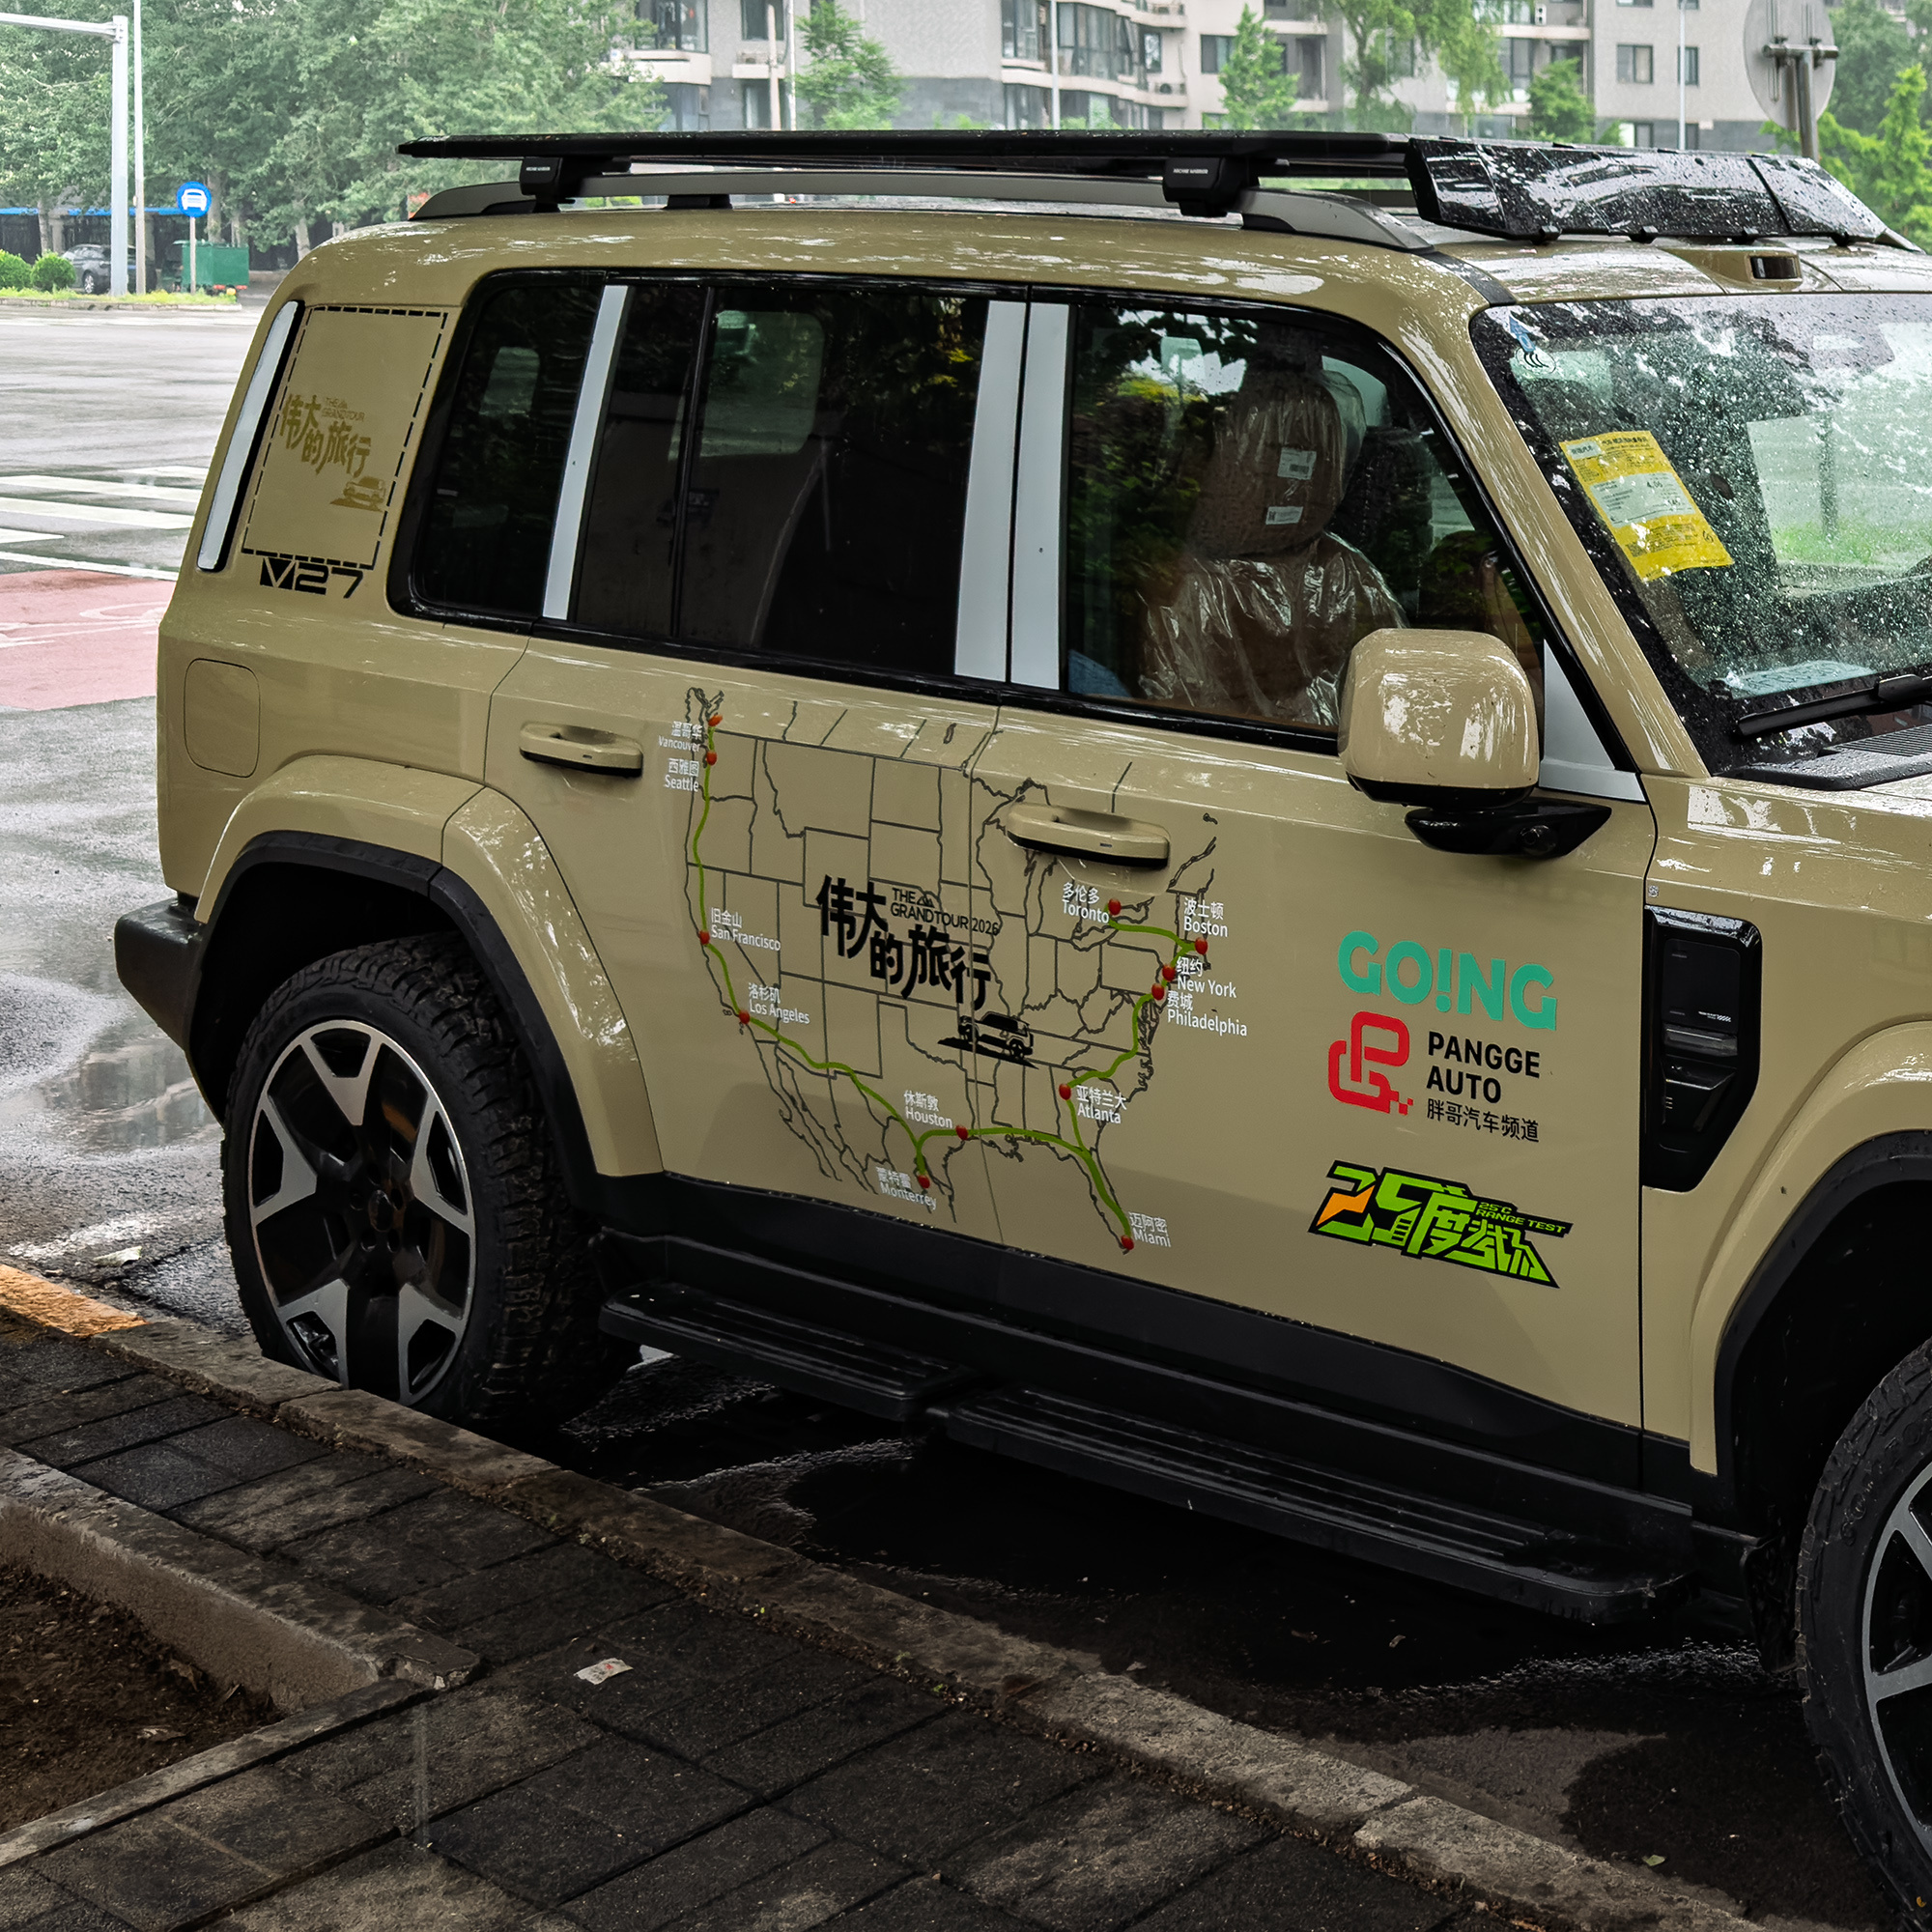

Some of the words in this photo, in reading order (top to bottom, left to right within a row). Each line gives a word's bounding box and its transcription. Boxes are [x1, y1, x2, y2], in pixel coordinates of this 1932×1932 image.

[279, 394, 322, 450] 伟大
[301, 421, 371, 478] 的旅行
[671, 721, 703, 739] 温哥华
[658, 735, 700, 752] Vancouver
[668, 758, 699, 777] 西雅图
[665, 774, 699, 792] Seattle
[892, 888, 916, 904] THE
[1062, 882, 1100, 904] 多伦多
[711, 907, 742, 928] 旧金山
[816, 874, 888, 958] 伟大
[1062, 899, 1110, 924] Toronto
[1183, 897, 1225, 920] 波士顿
[711, 924, 730, 941] San
[733, 929, 781, 952] Francisco
[972, 918, 1001, 936] 2026
[1183, 917, 1228, 937] Boston
[870, 923, 991, 1010] 的旅行
[1176, 956, 1204, 978] 纽约
[1177, 976, 1206, 994] New
[1208, 980, 1236, 999] York
[1338, 930, 1557, 1031] GO!NG
[749, 982, 781, 1005] 洛杉矶
[1167, 990, 1194, 1011] 费城
[749, 999, 768, 1015] Los
[769, 1004, 810, 1024] Angeles
[1167, 1009, 1247, 1037] Philadelphia
[1428, 1031, 1541, 1079] PANGGE
[1426, 1065, 1502, 1104] AUTO
[903, 1090, 939, 1112] 休斯敦
[1076, 1085, 1127, 1111] 亚特兰大
[904, 1106, 952, 1128] Houston
[1077, 1102, 1122, 1124] Atlanta
[1427, 1098, 1540, 1143] 胖哥汽车频道
[879, 1181, 937, 1210] Monterrey
[1128, 1211, 1168, 1234] 迈阿密
[1475, 1208, 1526, 1226] RANGE
[1527, 1219, 1566, 1233] TEST
[1132, 1228, 1172, 1248] Miami
